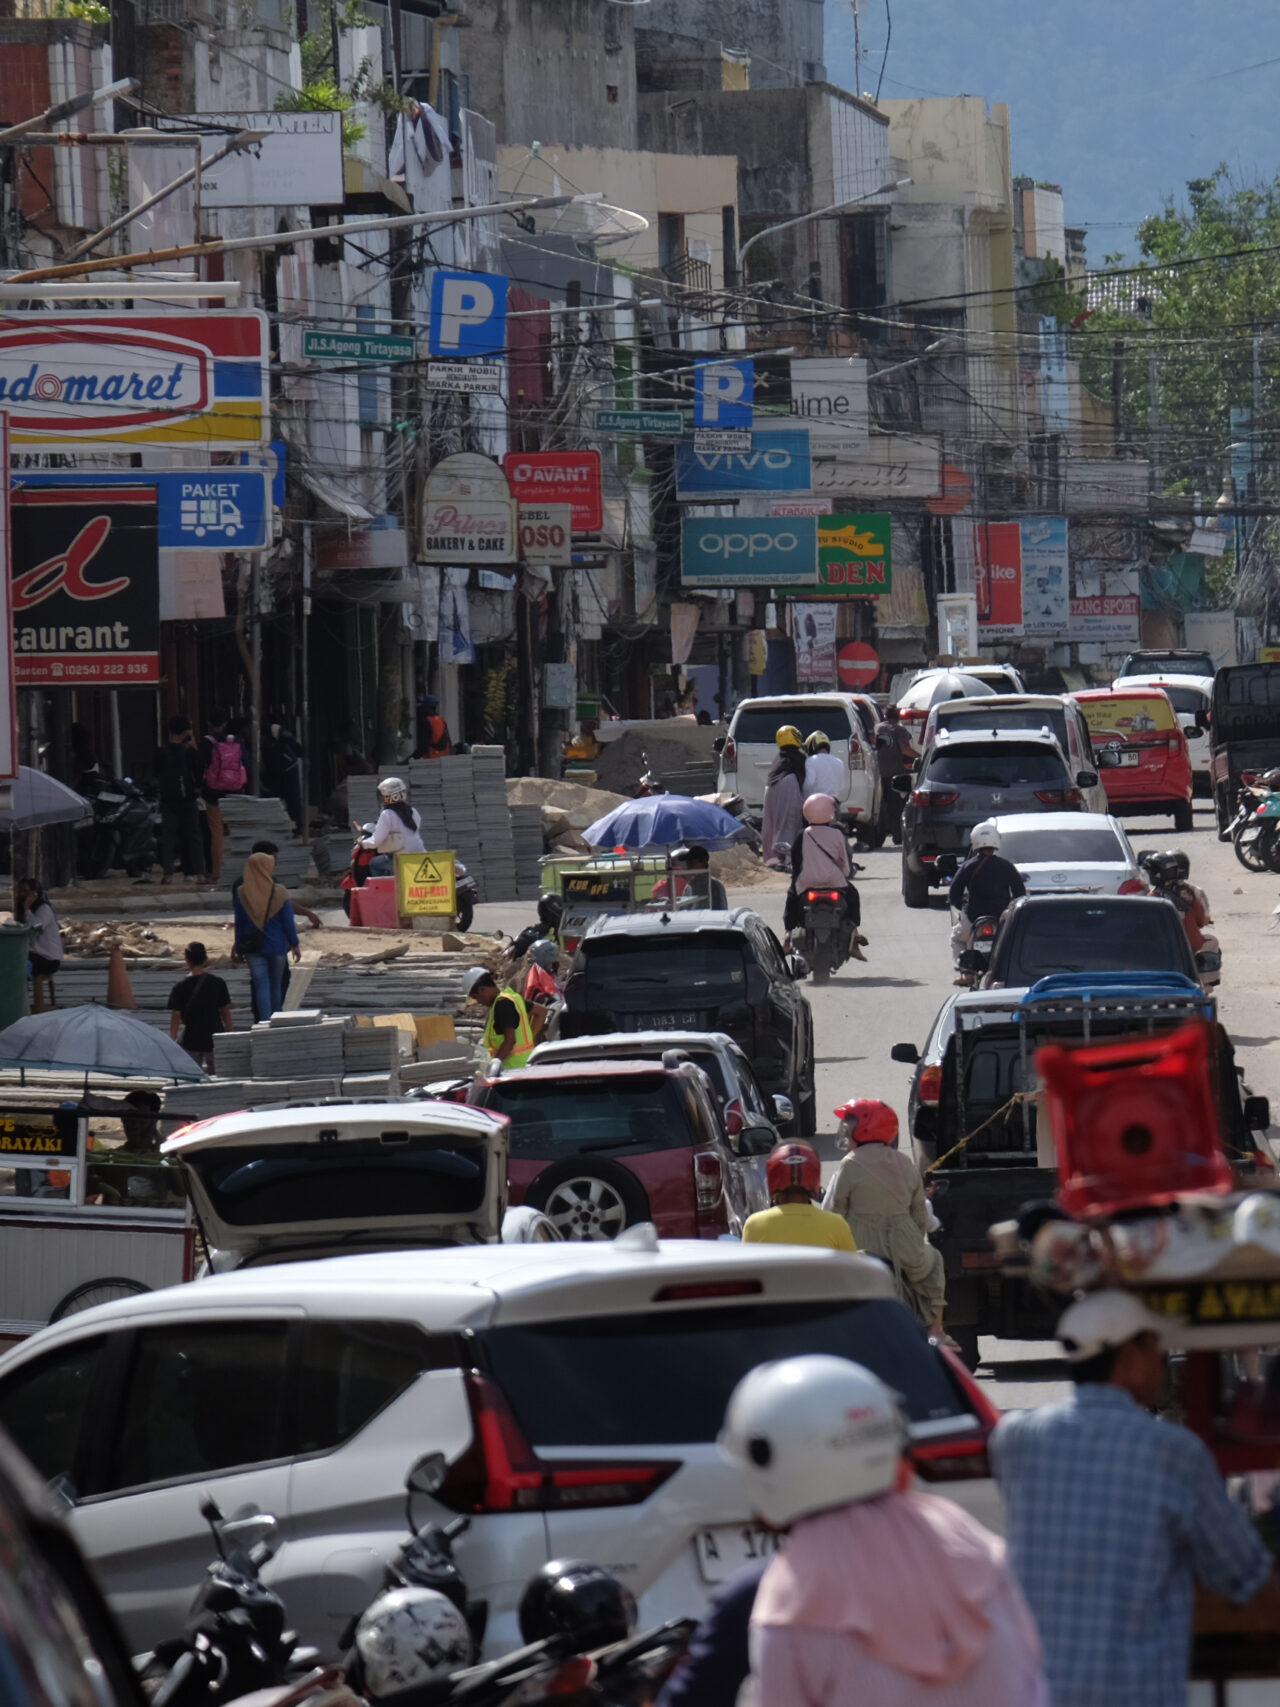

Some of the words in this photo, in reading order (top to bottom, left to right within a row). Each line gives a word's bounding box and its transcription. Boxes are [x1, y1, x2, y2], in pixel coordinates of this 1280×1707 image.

[439, 279, 495, 349] P
[364, 341, 412, 357] Tirtayasa
[430, 365, 464, 374] PARKIR
[468, 366, 498, 376] MOBIL
[463, 383, 499, 392] PARKIR
[703, 365, 746, 423] P
[533, 466, 592, 482] AVANT
[181, 483, 240, 498] PAKET
[426, 536, 466, 551] BAKERY
[468, 538, 475, 551] &
[478, 537, 505, 551] CAKE
[831, 536, 865, 551] STUDIO
[818, 560, 886, 586] DEN
[1103, 598, 1137, 614] SPORT
[65, 663, 101, 676] (0254)
[103, 663, 124, 675] 222
[127, 662, 149, 675] 936
[408, 885, 449, 898] HATI-HATI
[0, 1135, 63, 1152] RAYAKI
